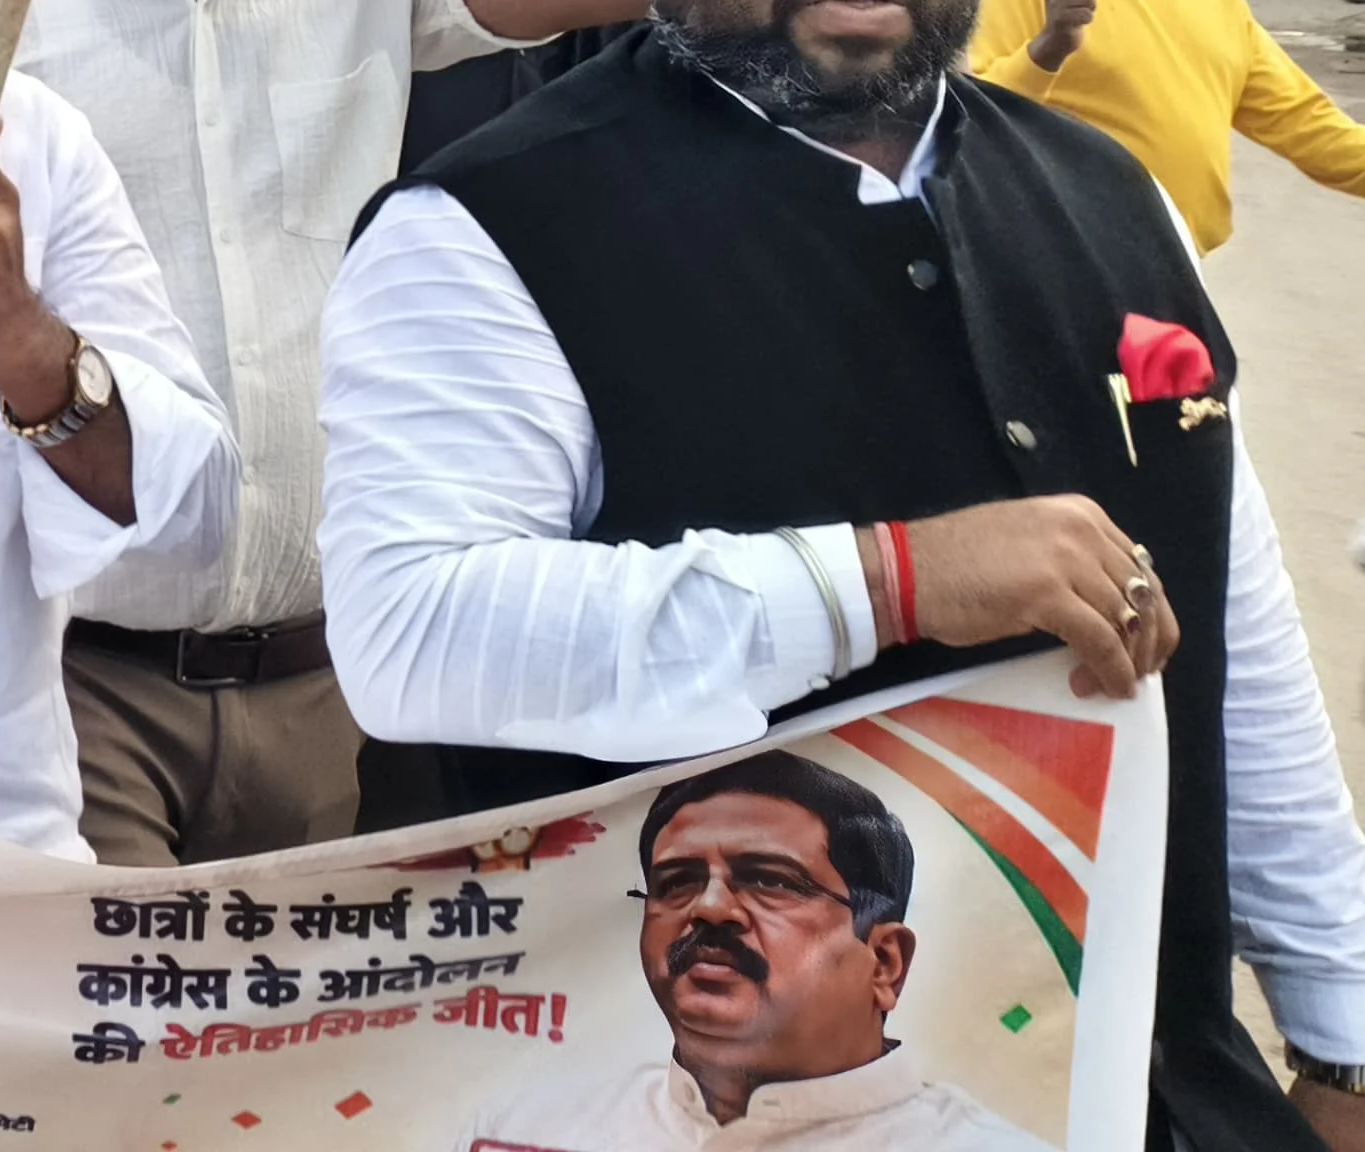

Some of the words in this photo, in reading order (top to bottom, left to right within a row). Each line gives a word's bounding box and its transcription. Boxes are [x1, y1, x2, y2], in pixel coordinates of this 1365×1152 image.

[92, 888, 210, 942] छात्रों
[222, 889, 278, 942] के
[289, 888, 415, 943] संघर्ष
[429, 882, 524, 938] और
[78, 954, 231, 1010] कांग्रेस
[244, 955, 301, 1009] के
[318, 951, 526, 1003] आंदोलन
[73, 1021, 144, 1065] की
[160, 1002, 422, 1061] ऐतिहासिक
[433, 985, 567, 1043] जीत!
